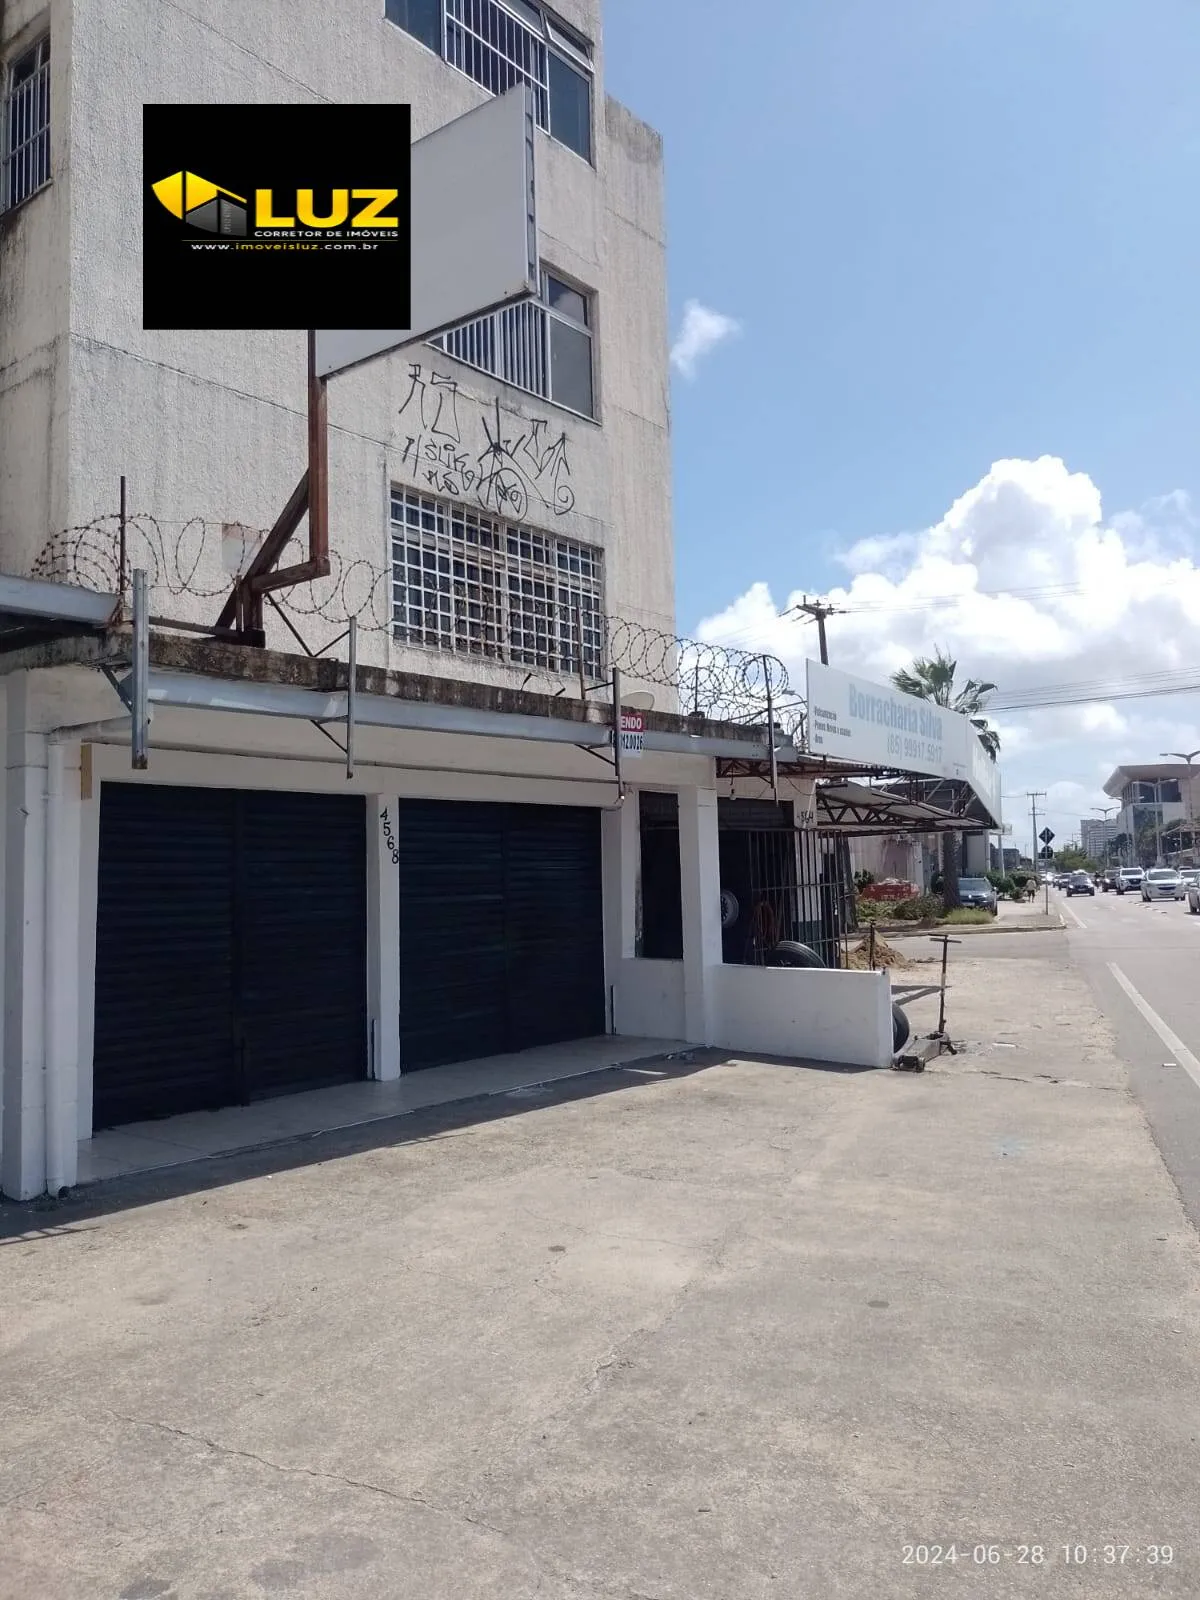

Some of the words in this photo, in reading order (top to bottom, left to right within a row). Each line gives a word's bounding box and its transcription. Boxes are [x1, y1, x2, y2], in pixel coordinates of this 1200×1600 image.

[617, 714, 643, 730] ENDO
[849, 683, 918, 734] Borracharia
[919, 706, 943, 741] Silva
[379, 806, 400, 865] 4568
